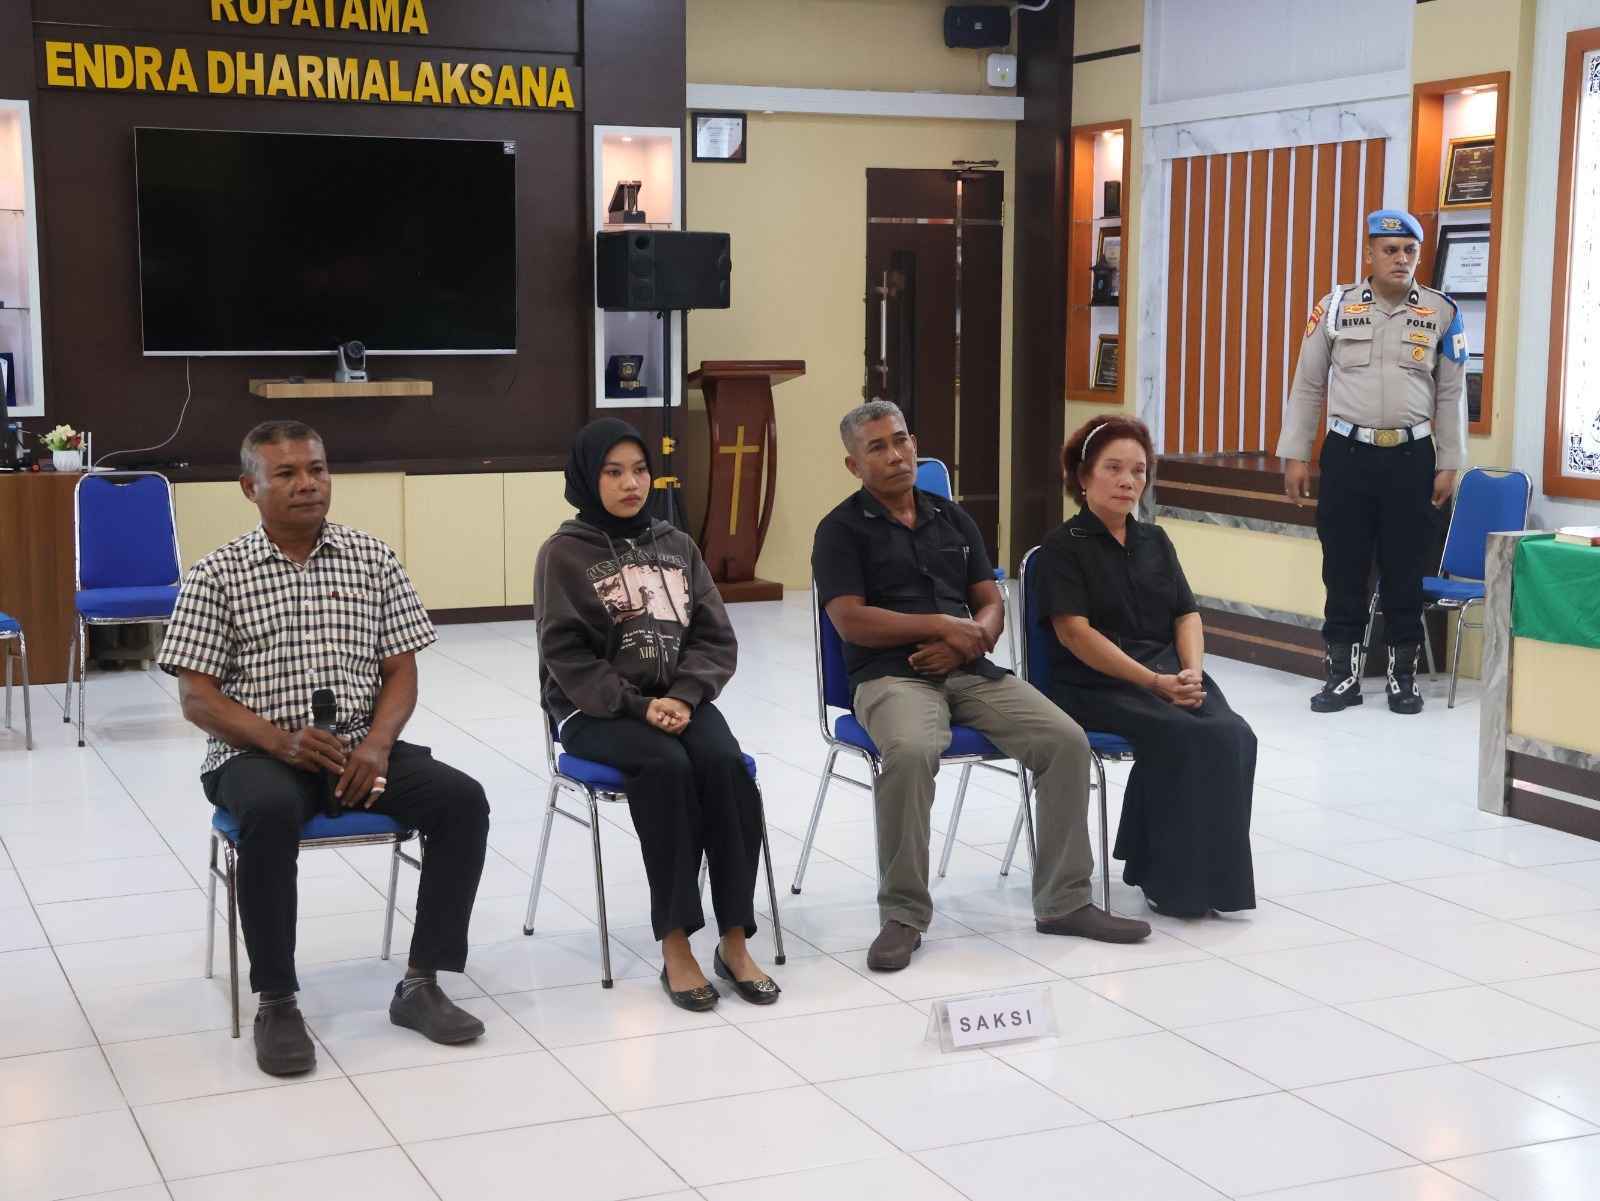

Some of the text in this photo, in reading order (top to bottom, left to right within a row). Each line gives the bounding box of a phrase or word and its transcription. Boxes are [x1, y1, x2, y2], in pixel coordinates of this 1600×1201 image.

[45, 41, 576, 108] ENDRA DHARMALAKSANA
[1341, 317, 1372, 327] RIVAL
[1406, 318, 1437, 330] POLRI
[959, 1009, 1032, 1033] SAKSI
